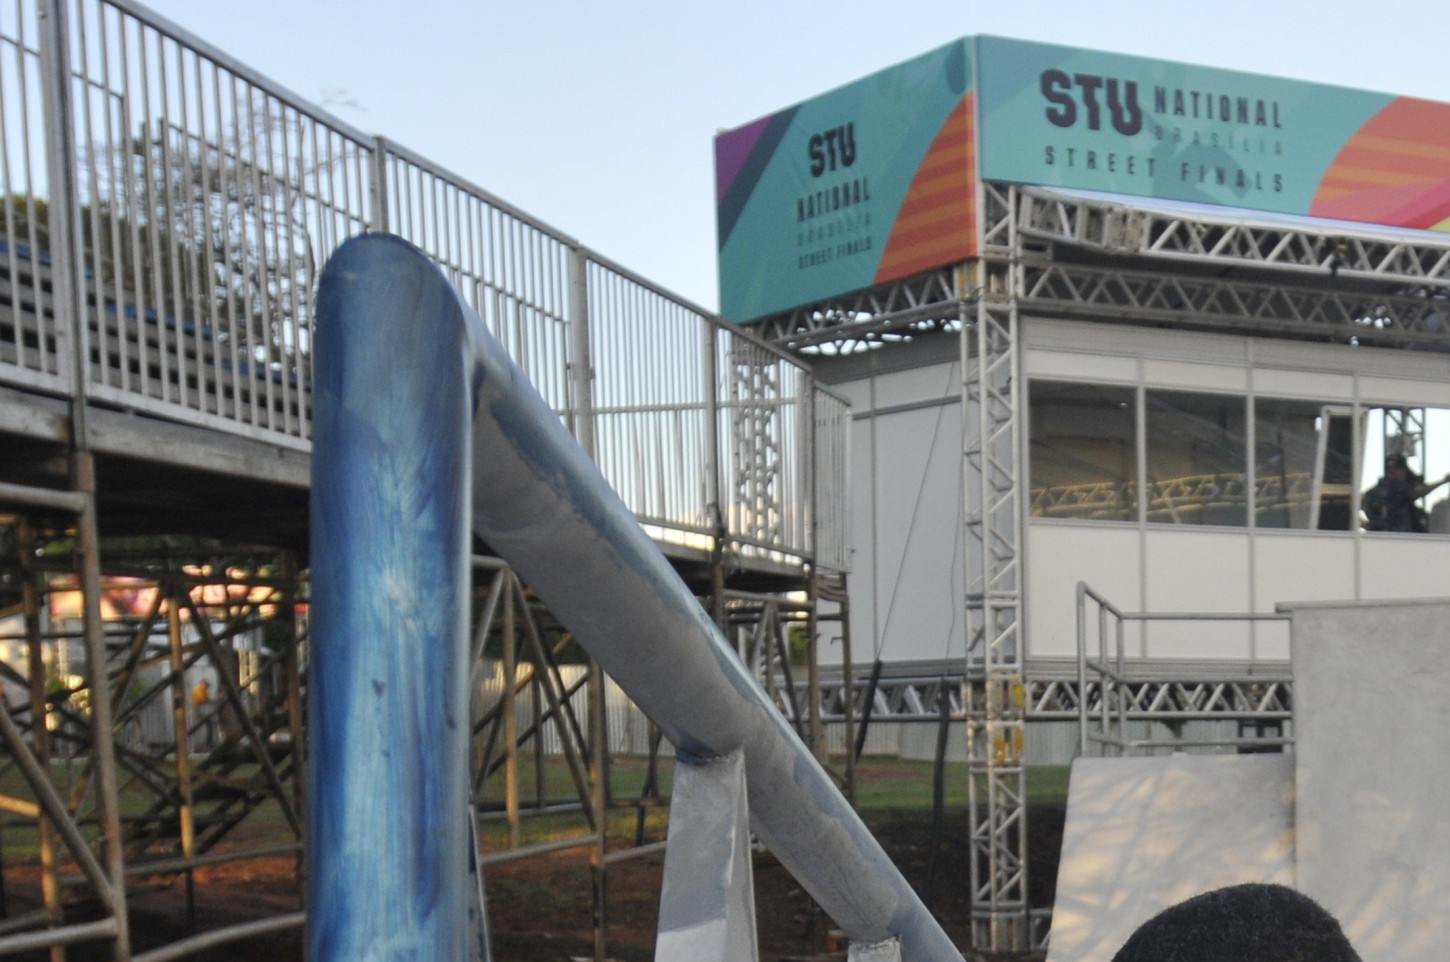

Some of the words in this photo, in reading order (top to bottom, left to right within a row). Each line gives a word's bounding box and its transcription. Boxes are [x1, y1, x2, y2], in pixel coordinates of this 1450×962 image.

[1039, 68, 1143, 136] STU
[1154, 86, 1282, 129] NATIONAL
[808, 121, 856, 177] STU
[1045, 146, 1156, 177] STREET
[1181, 162, 1283, 192] FINALS
[797, 176, 870, 222] NATIONAL
